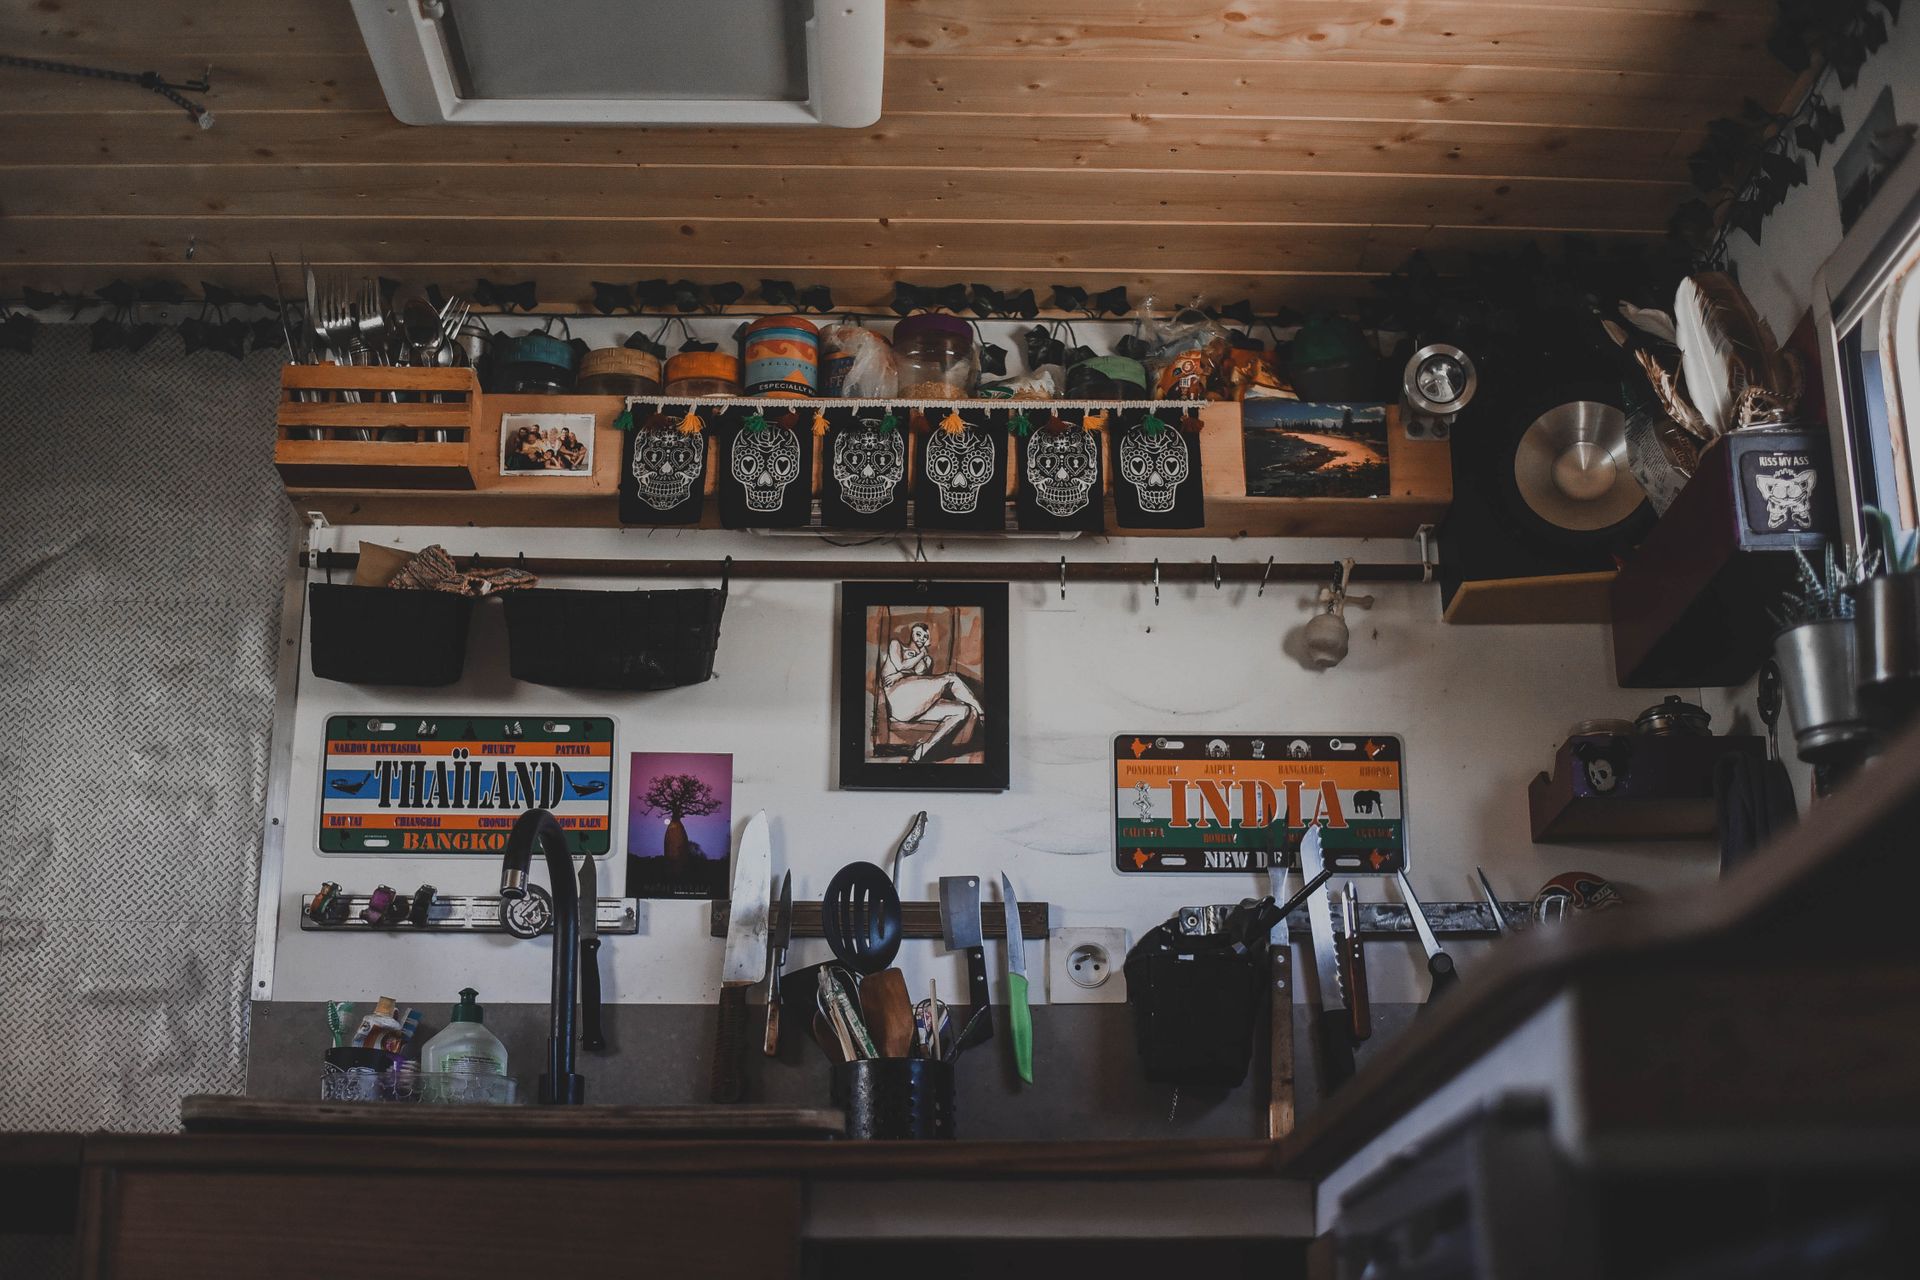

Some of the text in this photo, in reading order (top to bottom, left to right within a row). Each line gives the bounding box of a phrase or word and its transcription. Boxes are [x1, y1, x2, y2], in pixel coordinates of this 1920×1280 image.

[759, 382, 808, 393] ESPECIALLY
[1759, 456, 1809, 467] KISS MY ASS
[481, 744, 516, 754] PHUKET
[555, 745, 590, 755] PATTAYA
[1204, 764, 1236, 776] JAIPUR
[1277, 764, 1327, 776] BANGALORE
[1359, 765, 1393, 778] BHOPAL
[373, 747, 564, 810] THAÏLAND
[1168, 779, 1350, 829] INDIA
[1202, 832, 1238, 844] BOMBAY
[1203, 851, 1250, 868] NEW
